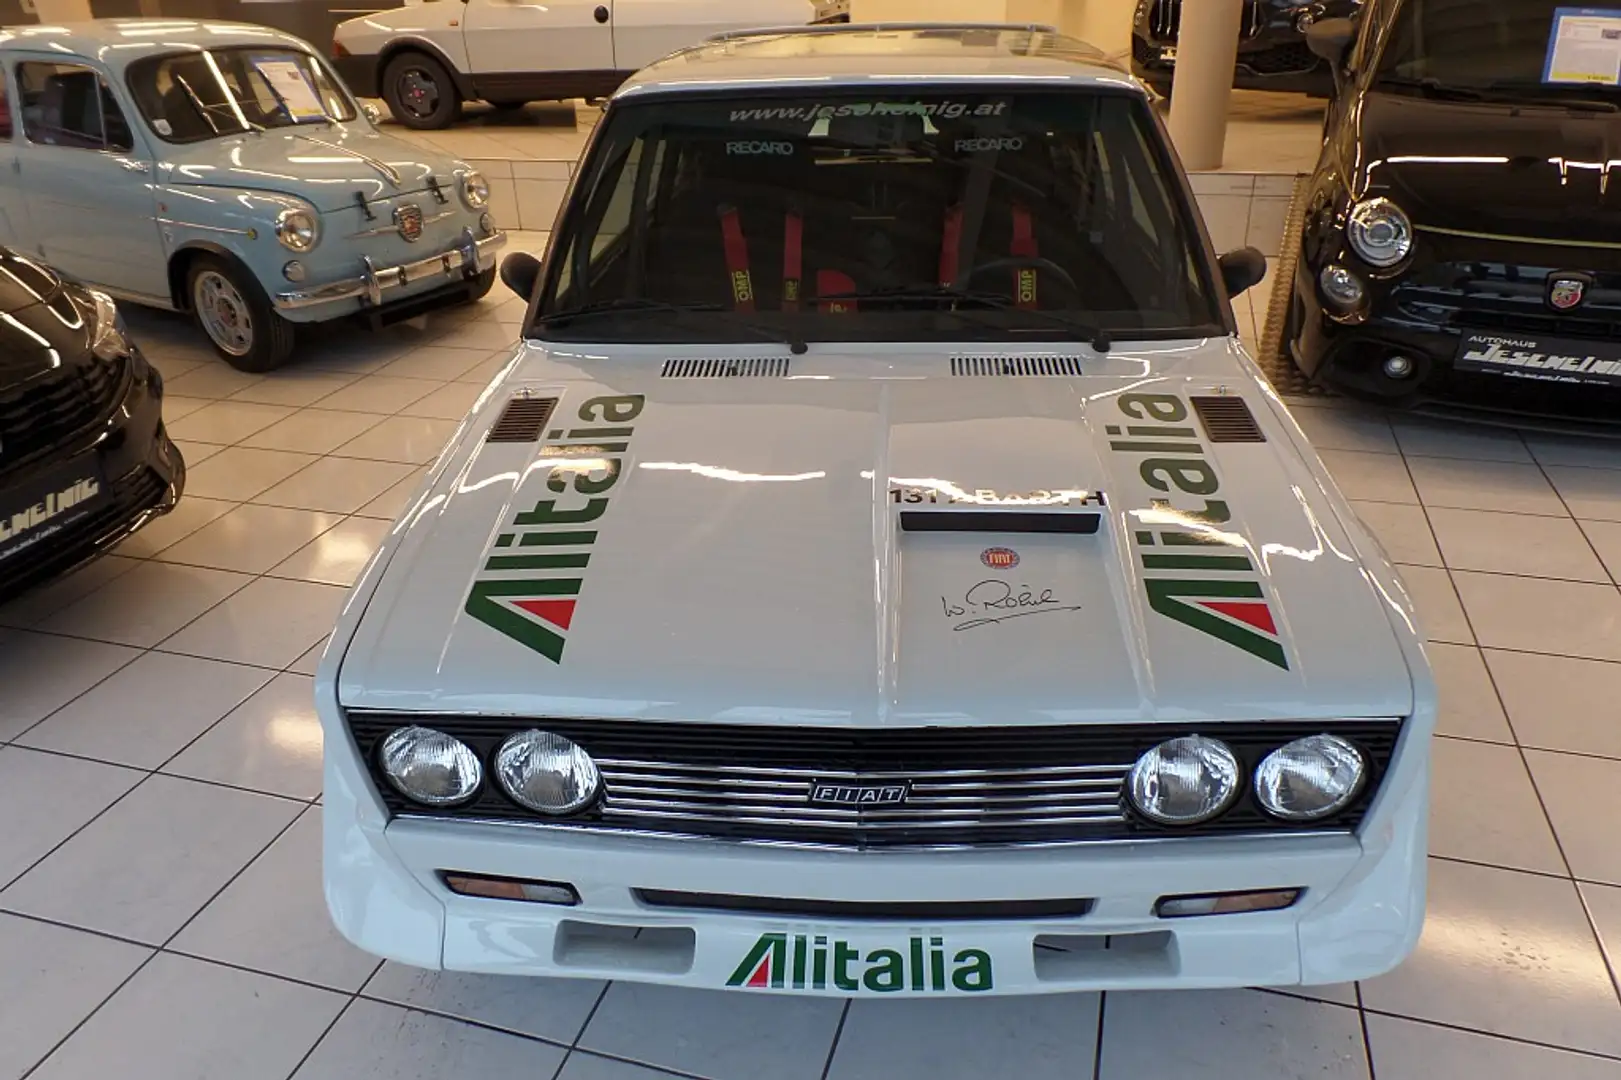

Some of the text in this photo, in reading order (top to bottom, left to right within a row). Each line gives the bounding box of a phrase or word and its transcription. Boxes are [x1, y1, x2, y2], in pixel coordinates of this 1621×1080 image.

[726, 141, 793, 155] RECARO
[954, 137, 1022, 152] RECARO
[735, 271, 749, 301] OMP
[1021, 270, 1032, 302] OMP
[1468, 335, 1538, 348] AUTOHAUS
[889, 489, 938, 503] 131
[465, 394, 645, 664] Alitalia
[818, 787, 902, 801] FIAT
[725, 932, 993, 992] Alitalia
